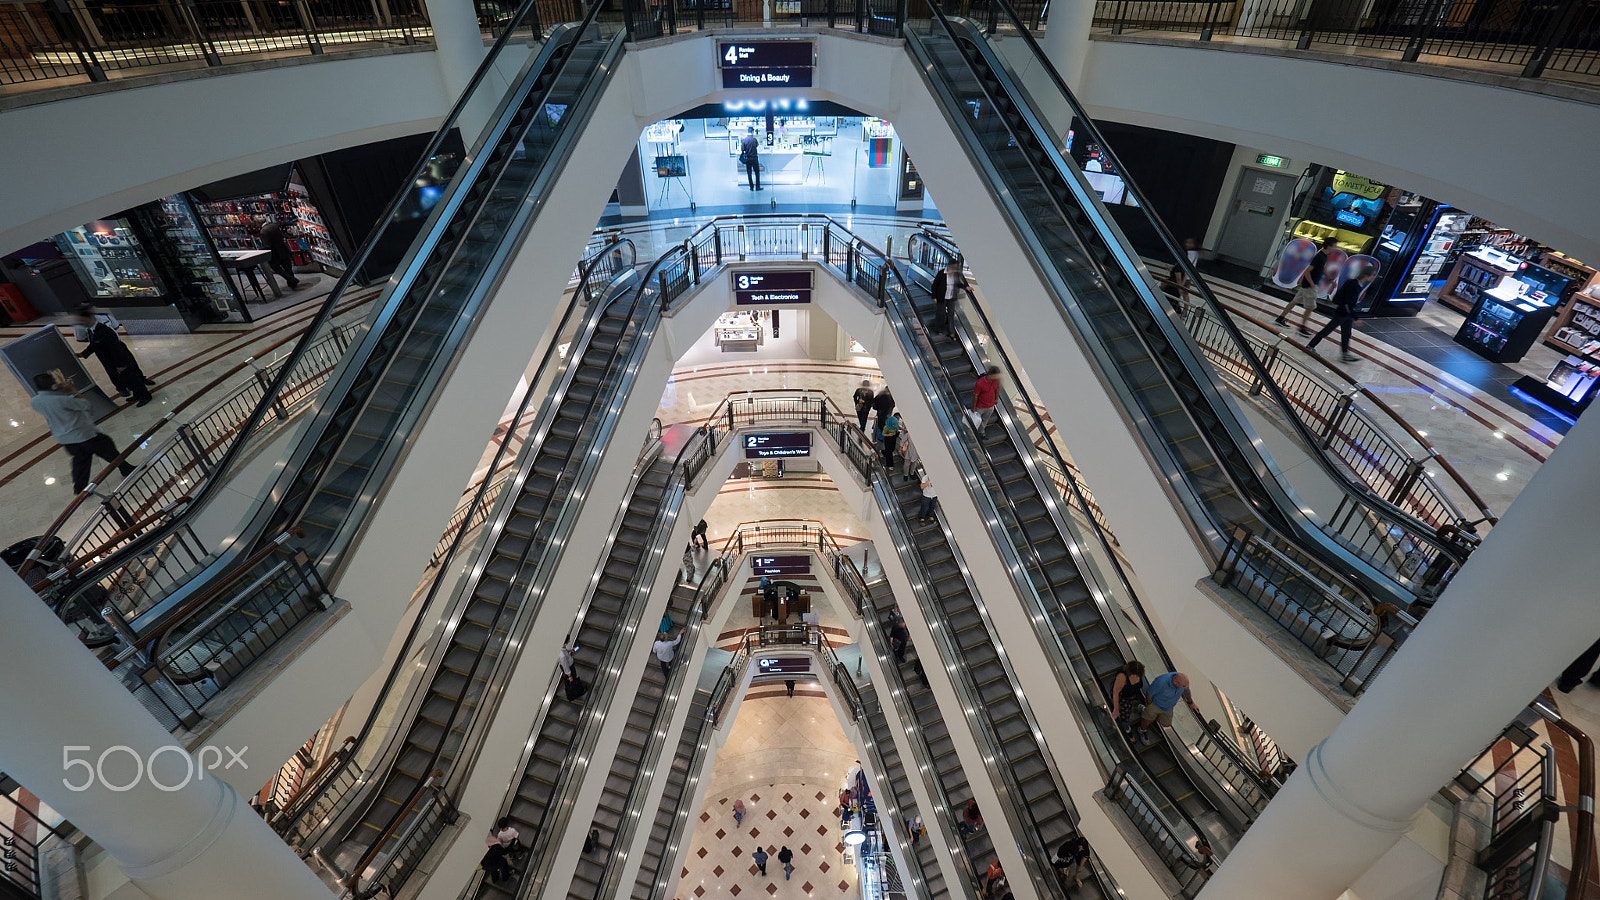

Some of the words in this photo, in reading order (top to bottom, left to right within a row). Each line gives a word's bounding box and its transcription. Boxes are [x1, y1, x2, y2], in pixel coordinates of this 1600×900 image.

[725, 46, 738, 64] 4
[739, 74, 761, 83] Dining
[761, 74, 767, 82] &
[767, 74, 790, 83] Beauty
[738, 275, 750, 289] 3
[747, 436, 757, 447] 2
[755, 558, 762, 567] 1
